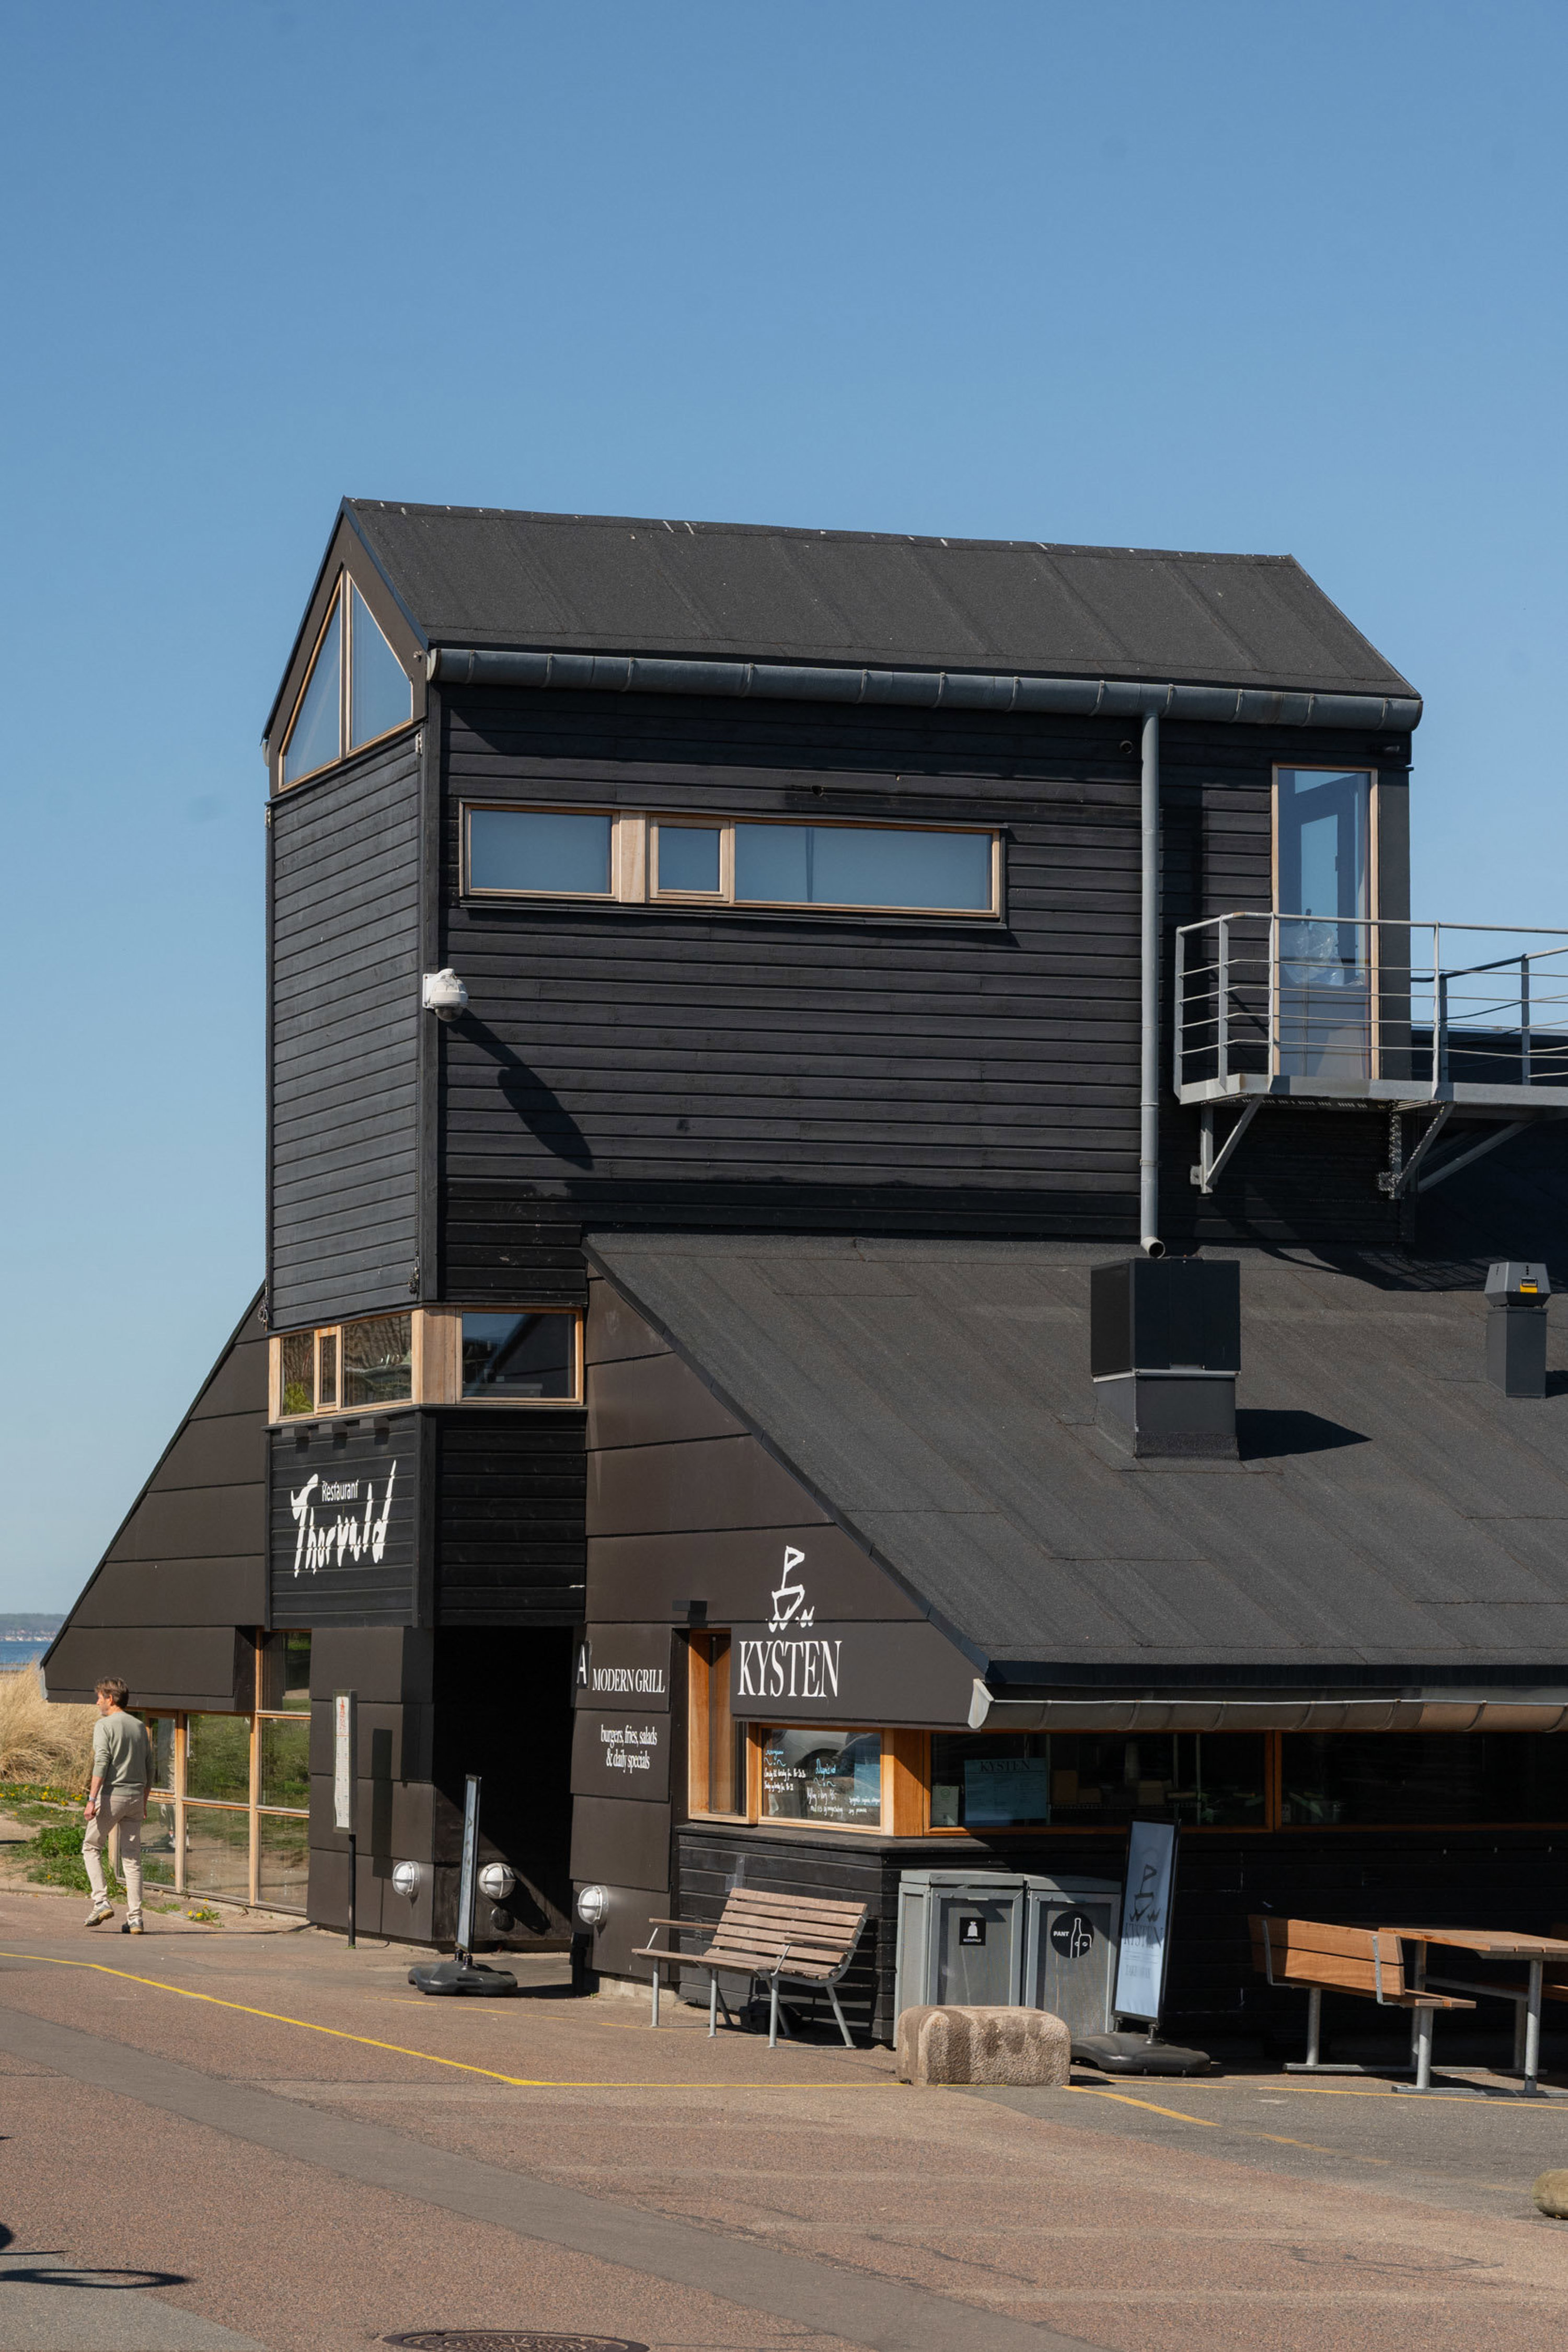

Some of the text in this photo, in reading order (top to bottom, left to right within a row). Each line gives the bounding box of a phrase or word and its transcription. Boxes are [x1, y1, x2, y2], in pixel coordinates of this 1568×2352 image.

[321, 1479, 360, 1502] Restaurant
[576, 1644, 665, 1693] A MODERN GRILL
[737, 1640, 843, 1698] KYSTEN
[601, 1724, 658, 1749] burgers, fries, salads
[606, 1748, 650, 1774] & daily specials
[979, 1760, 1030, 1772] KYSTEN
